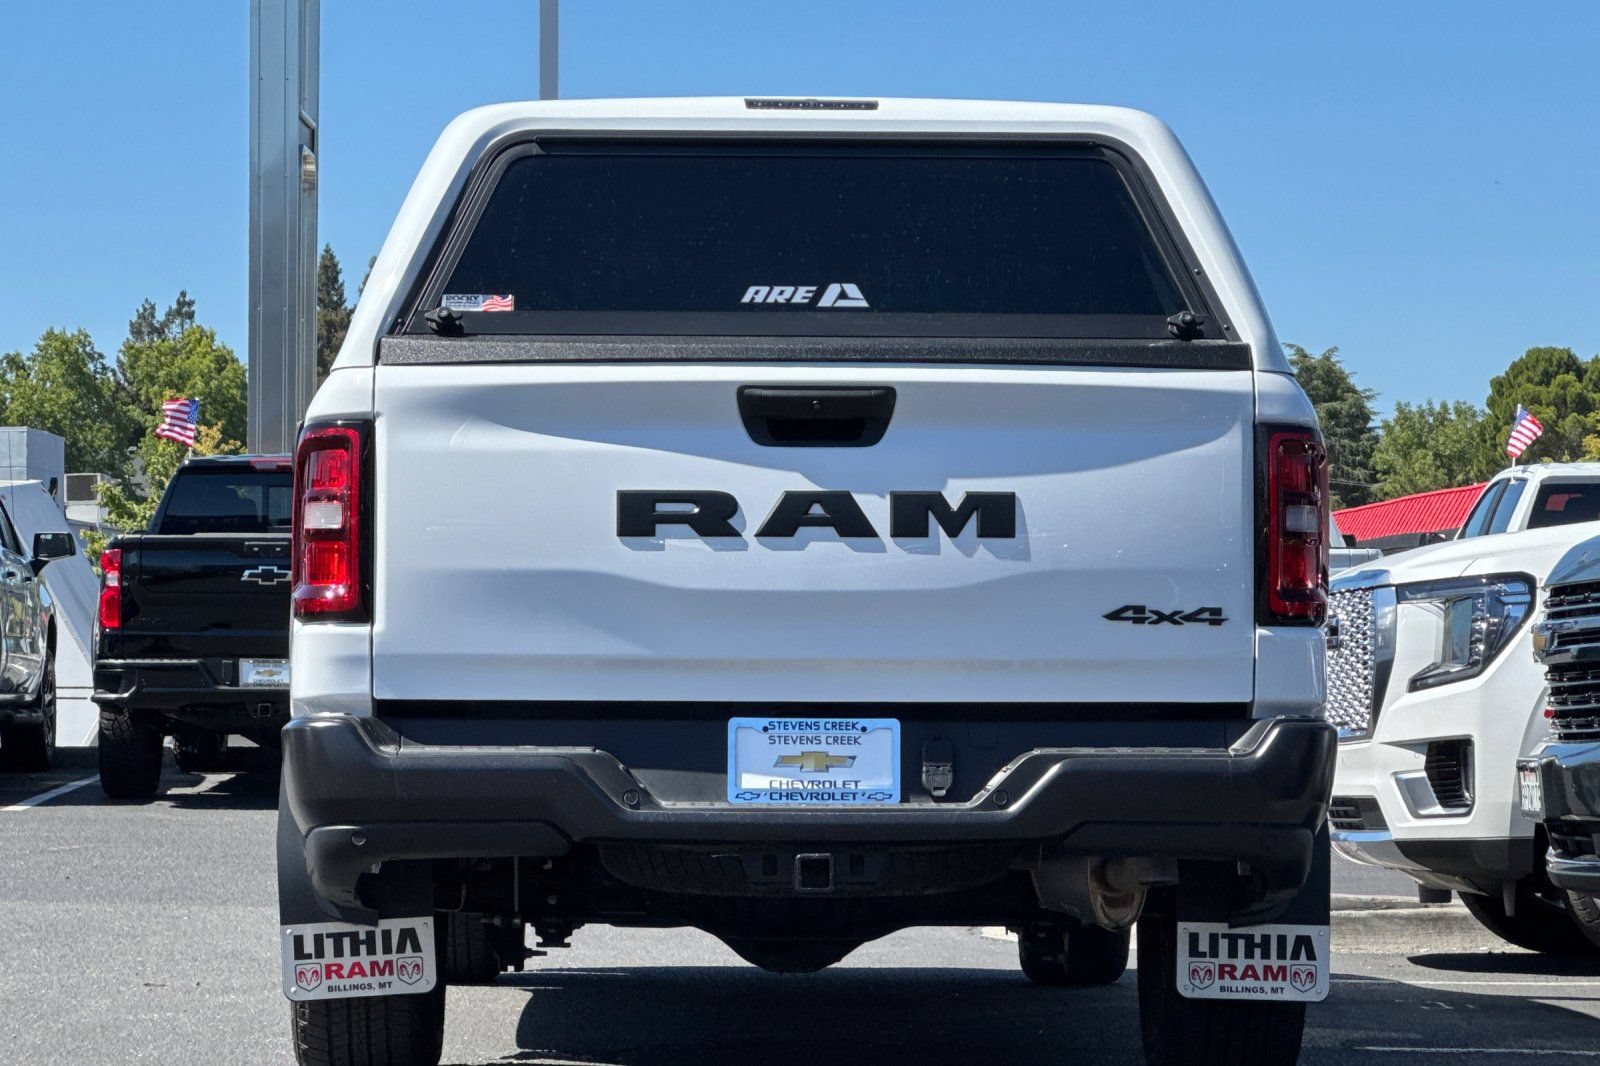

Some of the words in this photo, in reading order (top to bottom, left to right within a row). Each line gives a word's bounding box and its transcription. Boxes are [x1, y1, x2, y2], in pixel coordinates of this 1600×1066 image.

[740, 286, 819, 303] ARE
[617, 490, 1016, 538] RAM
[1101, 605, 1230, 626] 4x4
[768, 720, 821, 731] STEVENS
[823, 721, 860, 731] CREEK
[768, 735, 822, 745] STEVENS
[825, 735, 862, 745] CREEK
[769, 780, 861, 789] CHEVROLET
[769, 791, 860, 801] CHEVROLET
[293, 928, 423, 960] LITHIA
[1188, 932, 1317, 961] LITHIA
[324, 960, 394, 980] RAM
[1218, 963, 1287, 982] RAM
[327, 983, 376, 993] BILLINGS,
[378, 981, 393, 989] MT
[1219, 985, 1268, 995] BILLINGS,
